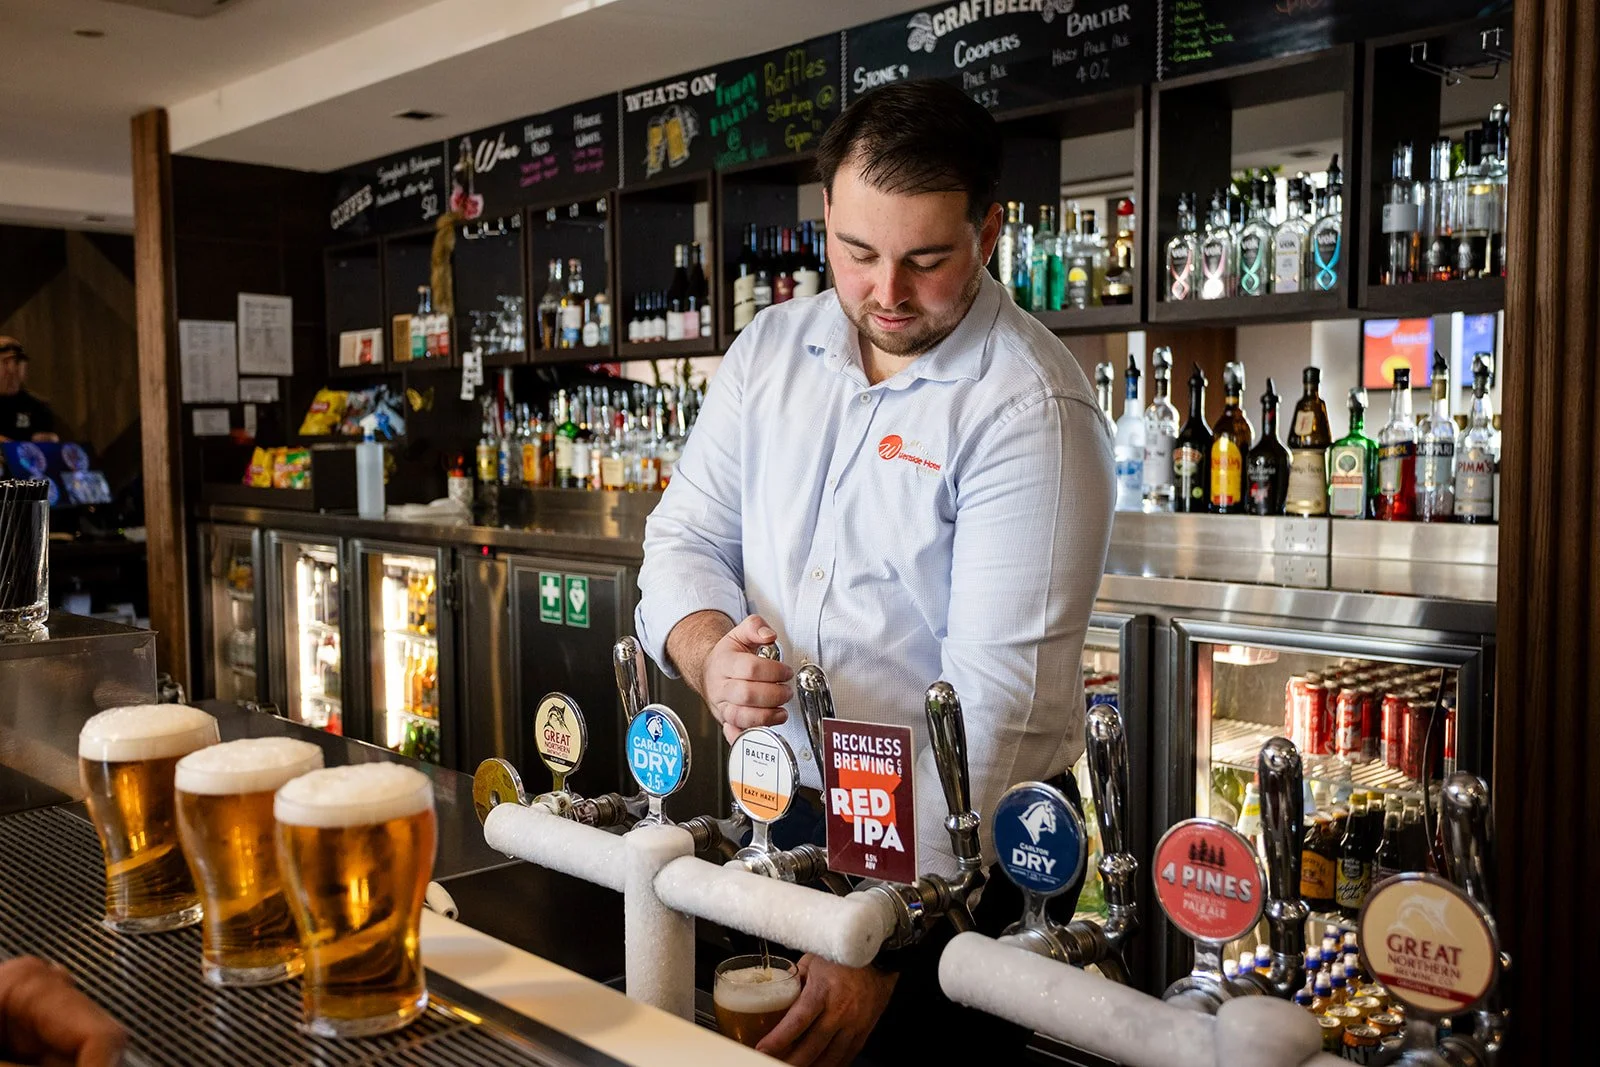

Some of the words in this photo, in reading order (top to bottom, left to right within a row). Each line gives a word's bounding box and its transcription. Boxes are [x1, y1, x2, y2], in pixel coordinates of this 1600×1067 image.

[1067, 4, 1131, 37] BALTER
[954, 33, 1021, 68] COOPERS
[763, 48, 827, 97] Raffles
[853, 64, 899, 94] STONE
[624, 80, 689, 113] WHATS
[690, 72, 717, 96] ON
[1458, 460, 1493, 473] PIMM'S
[544, 729, 571, 746] GREAT
[633, 736, 677, 756] CARLTON
[832, 731, 902, 757] RECKLESS
[634, 748, 678, 776] DRY
[745, 748, 776, 762] BALTER
[833, 751, 895, 776] BREWING
[830, 788, 891, 817] RED
[853, 815, 905, 852] IPA
[1012, 848, 1057, 875] DRY
[1019, 842, 1049, 856] CARLTON
[1162, 862, 1176, 885] 4
[1182, 865, 1252, 903] PINES
[1386, 933, 1462, 966] GREAT
[1388, 953, 1461, 979] NORTHERN
